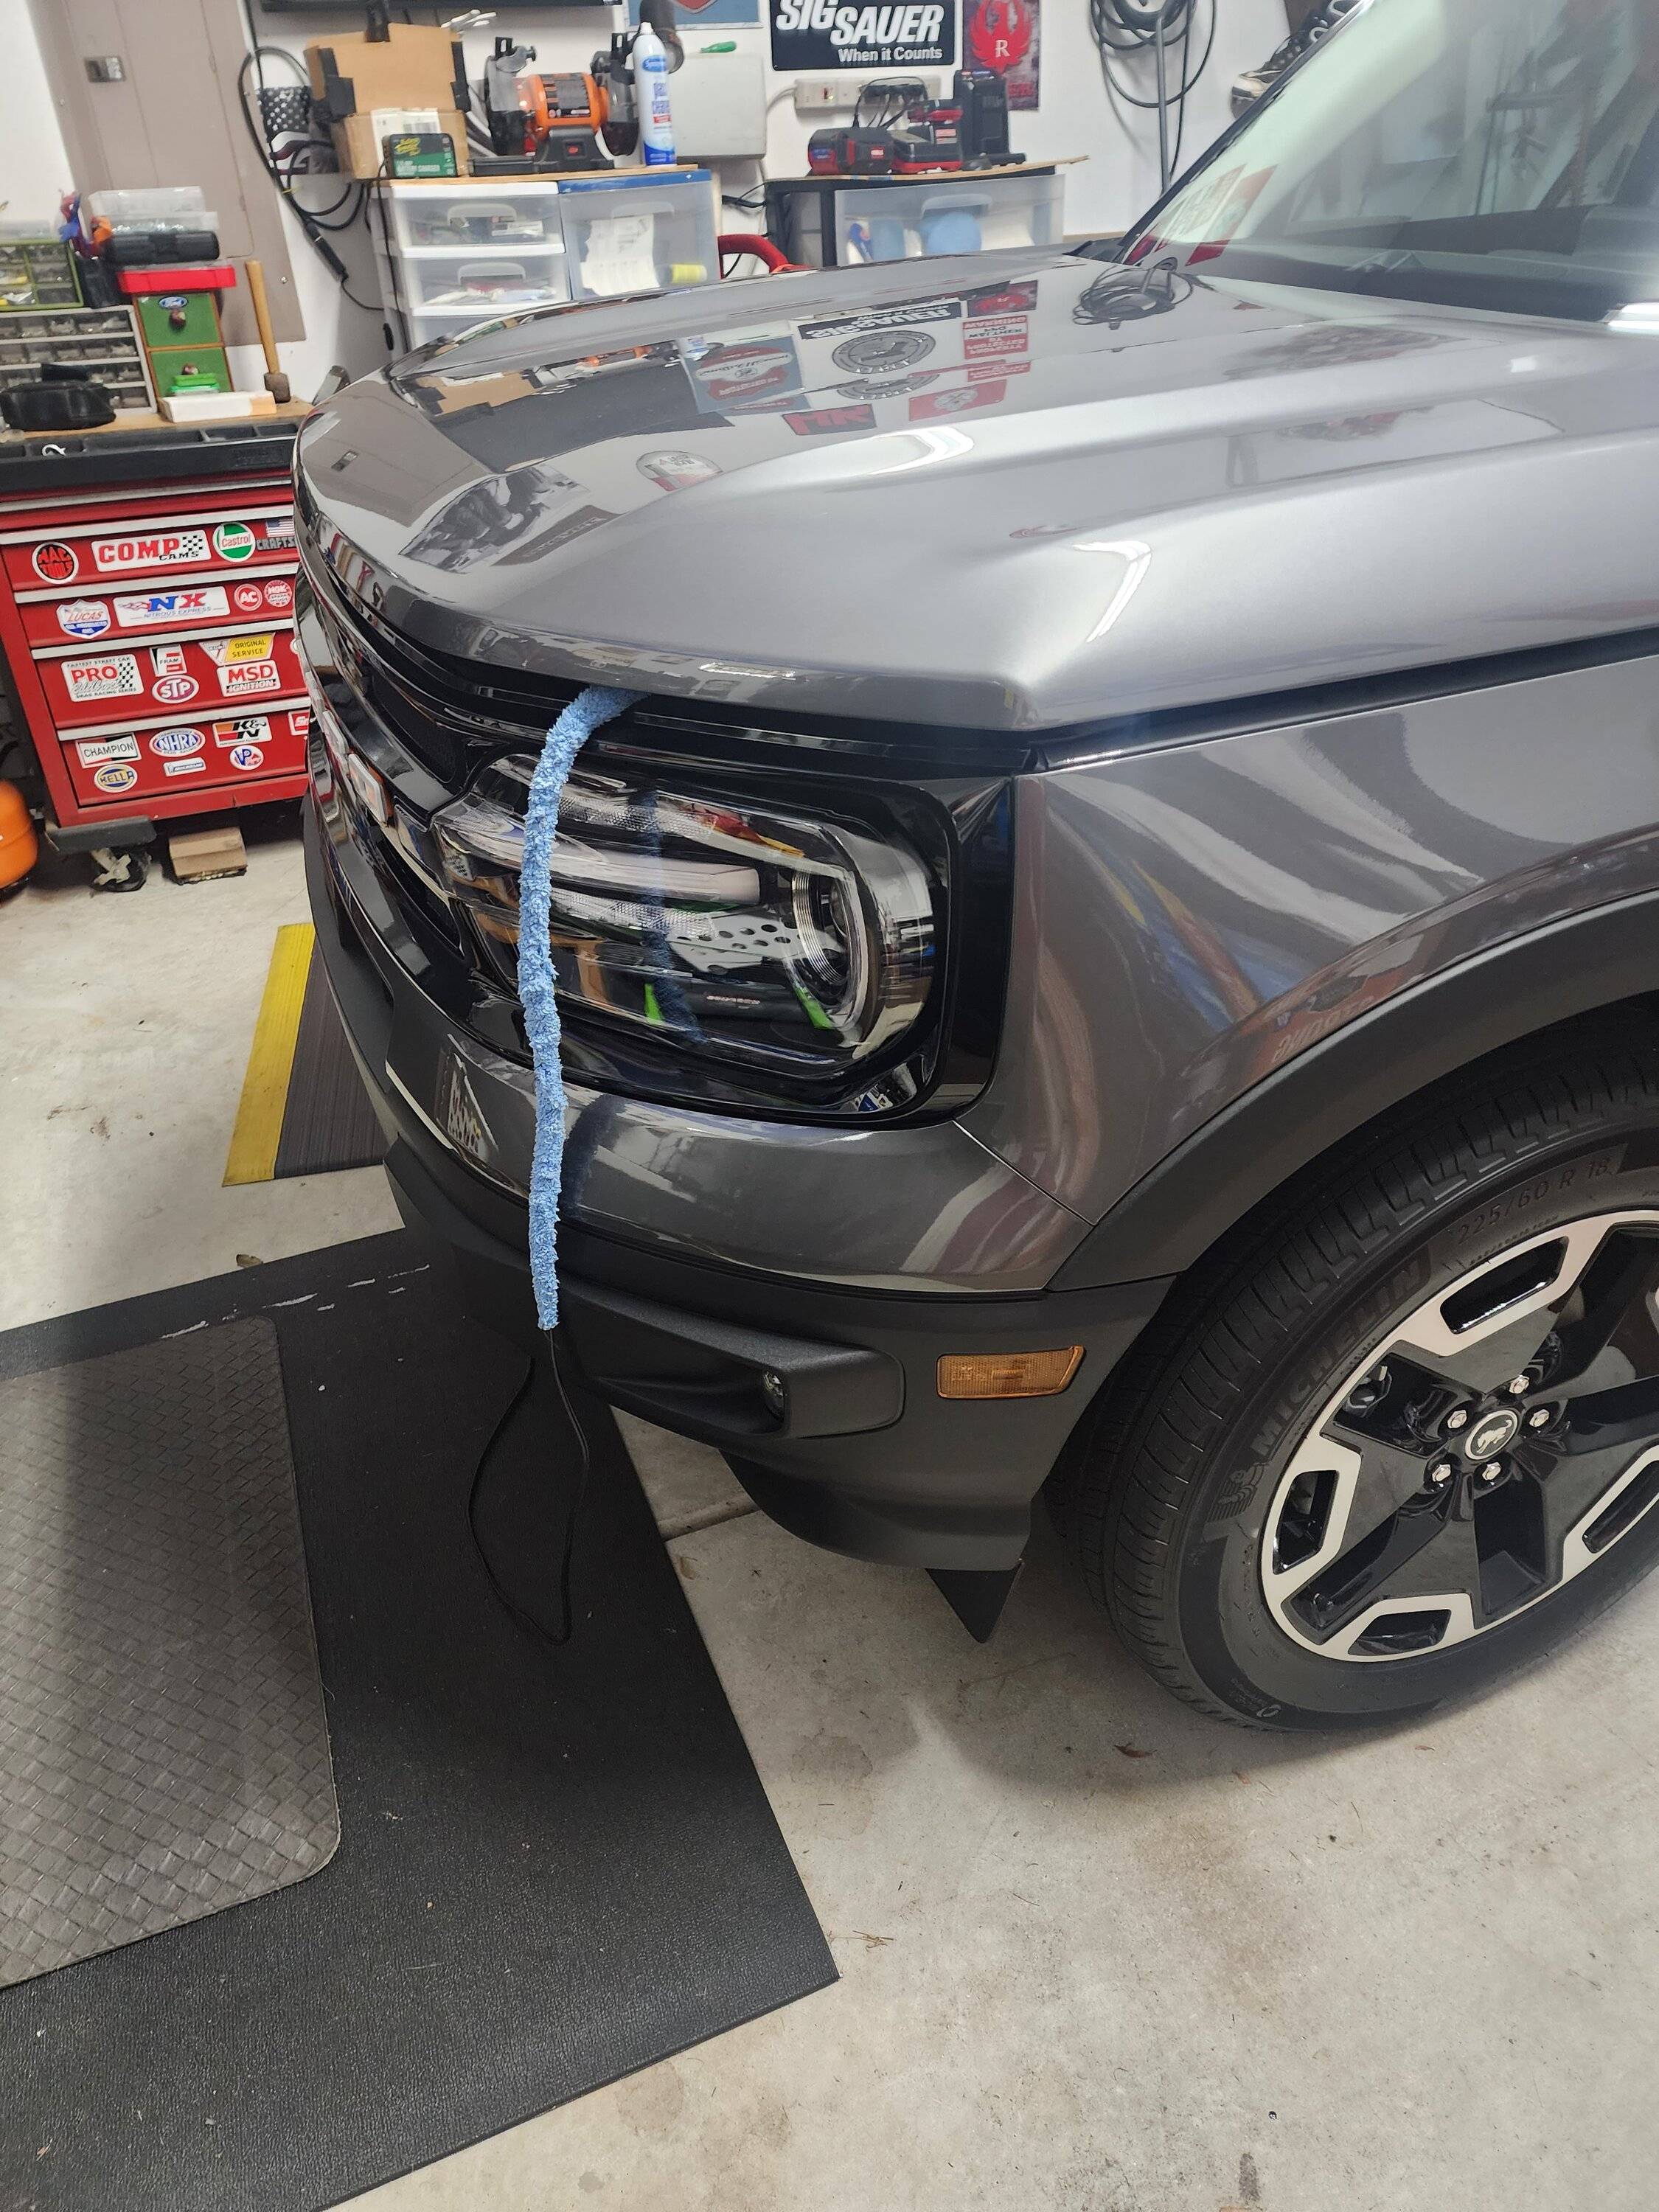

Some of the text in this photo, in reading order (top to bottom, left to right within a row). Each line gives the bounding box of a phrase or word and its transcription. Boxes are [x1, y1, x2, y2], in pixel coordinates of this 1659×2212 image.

[776, 0, 839, 30] SIG
[830, 4, 945, 46] SAUER
[838, 46, 943, 63] When it Counts
[995, 39, 1011, 58] R
[221, 533, 251, 548] Castrol
[98, 538, 180, 563] COMP
[159, 551, 200, 561] CAMS
[240, 591, 258, 603] AC
[68, 611, 103, 622] LUCAS
[178, 605, 212, 616] EXPRESS
[234, 639, 266, 649] ORIGINAL
[232, 648, 264, 658] SERVICE
[71, 666, 118, 684] PRO
[228, 664, 274, 684] MSD
[159, 678, 192, 699] STP
[228, 679, 274, 692] IGNITION
[83, 741, 133, 758] CHAMPION
[157, 734, 198, 751] NHRA
[234, 748, 252, 766] VP
[1458, 1180, 1548, 1245] 225/60
[1559, 1168, 1576, 1190] R
[1251, 1257, 1425, 1457] MICHELIN
